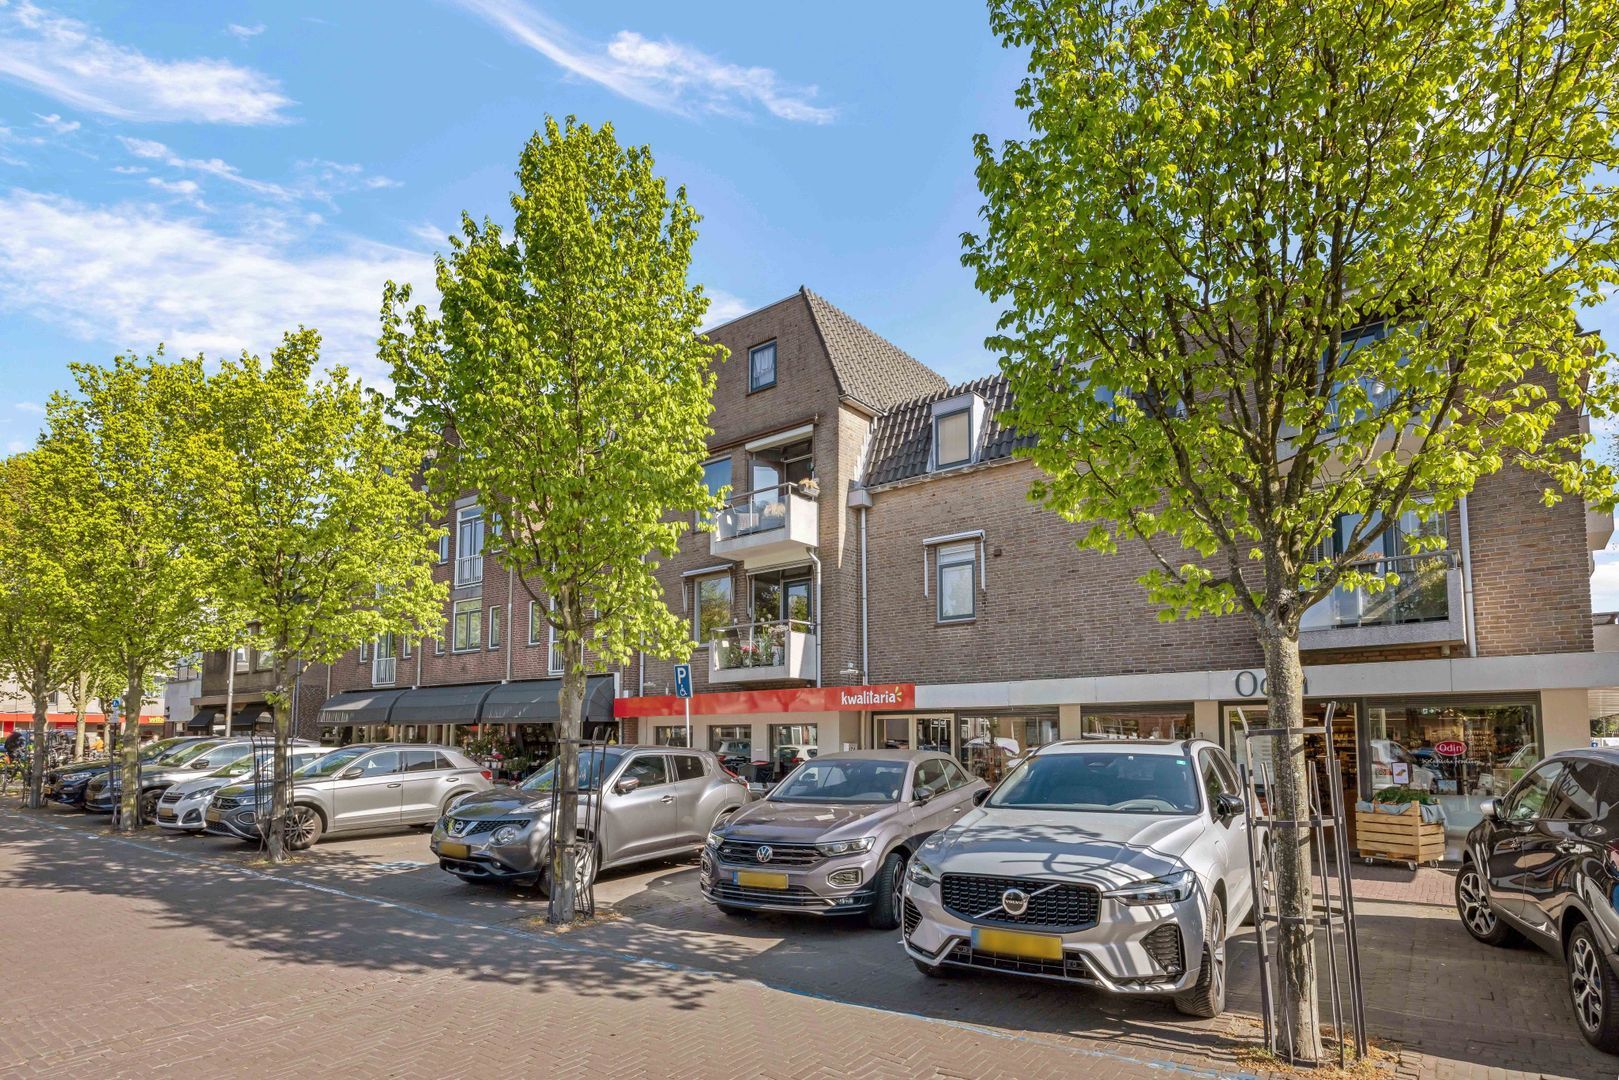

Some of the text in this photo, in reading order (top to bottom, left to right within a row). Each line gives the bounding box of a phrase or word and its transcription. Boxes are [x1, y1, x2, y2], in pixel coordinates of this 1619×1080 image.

[677, 667, 686, 684] P
[841, 690, 896, 705] kwalitaria
[1439, 744, 1462, 752] Odin
